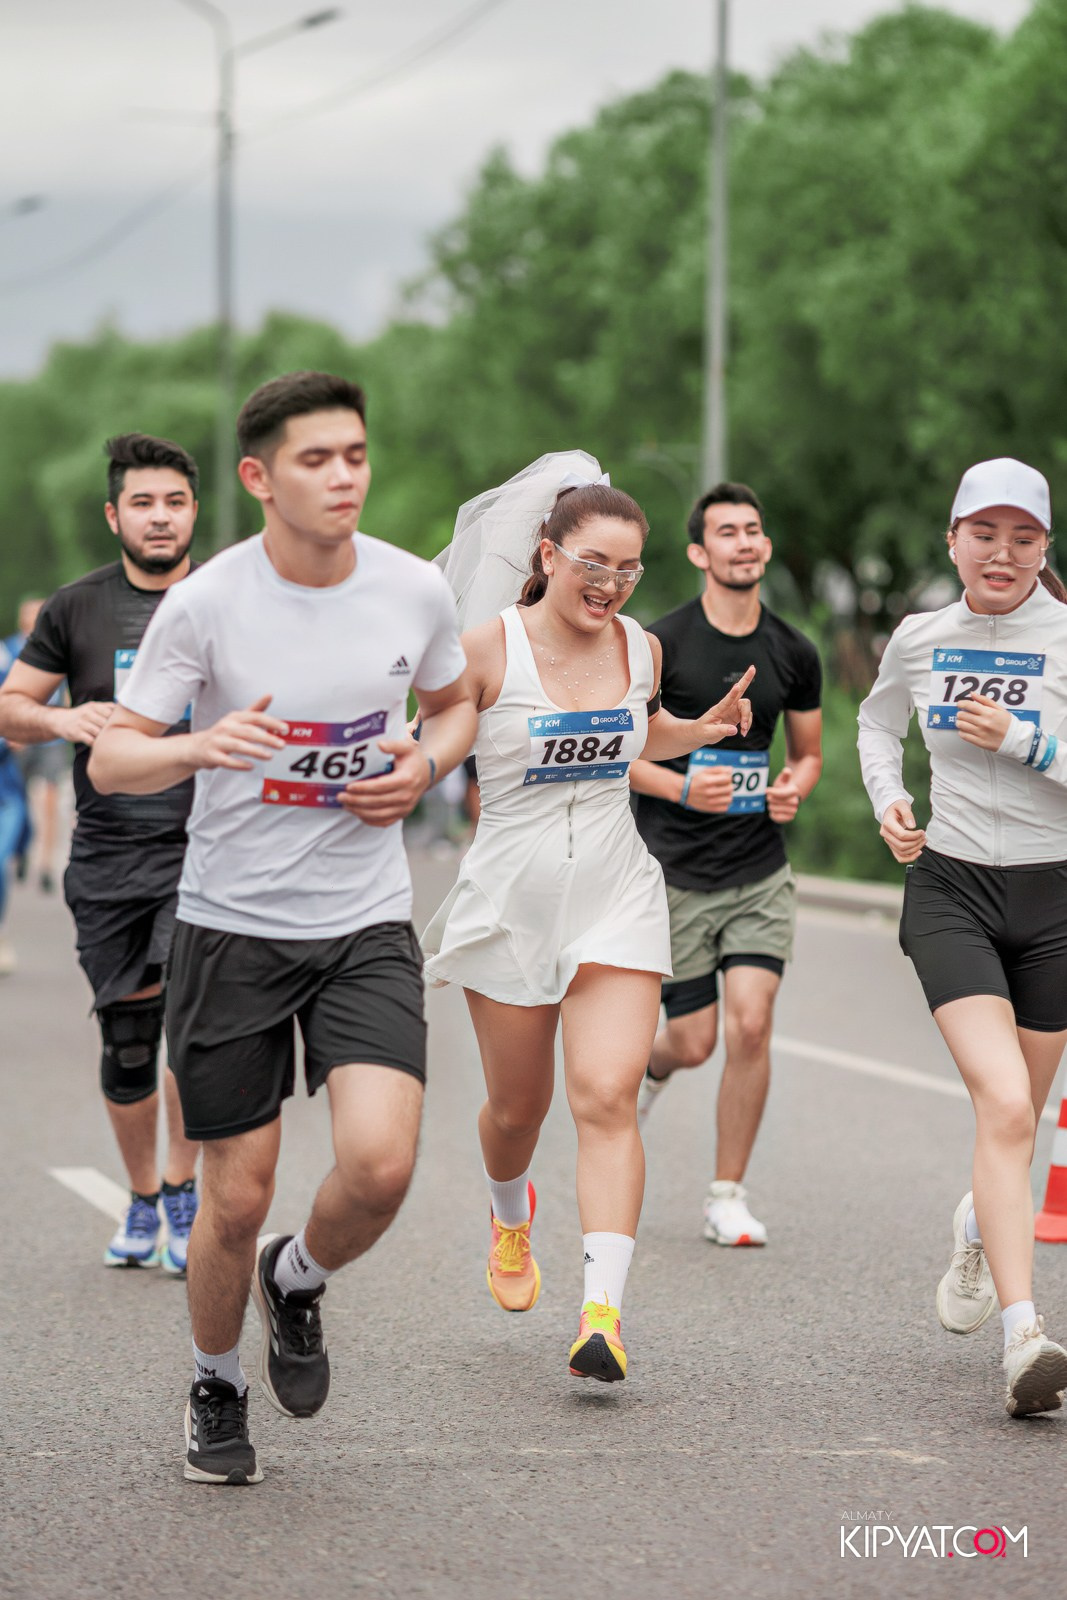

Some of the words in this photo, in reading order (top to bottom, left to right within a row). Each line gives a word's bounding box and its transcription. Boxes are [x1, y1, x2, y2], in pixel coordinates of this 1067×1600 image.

[937, 652, 946, 663] 5
[947, 655, 963, 663] KM
[1005, 658, 1028, 667] GROUP
[942, 675, 1029, 706] 1268
[534, 719, 543, 729] 5
[545, 719, 560, 728] KM
[600, 716, 619, 724] GROUP
[541, 735, 625, 765] 1884
[289, 743, 369, 780] 465
[732, 772, 760, 792] 90
